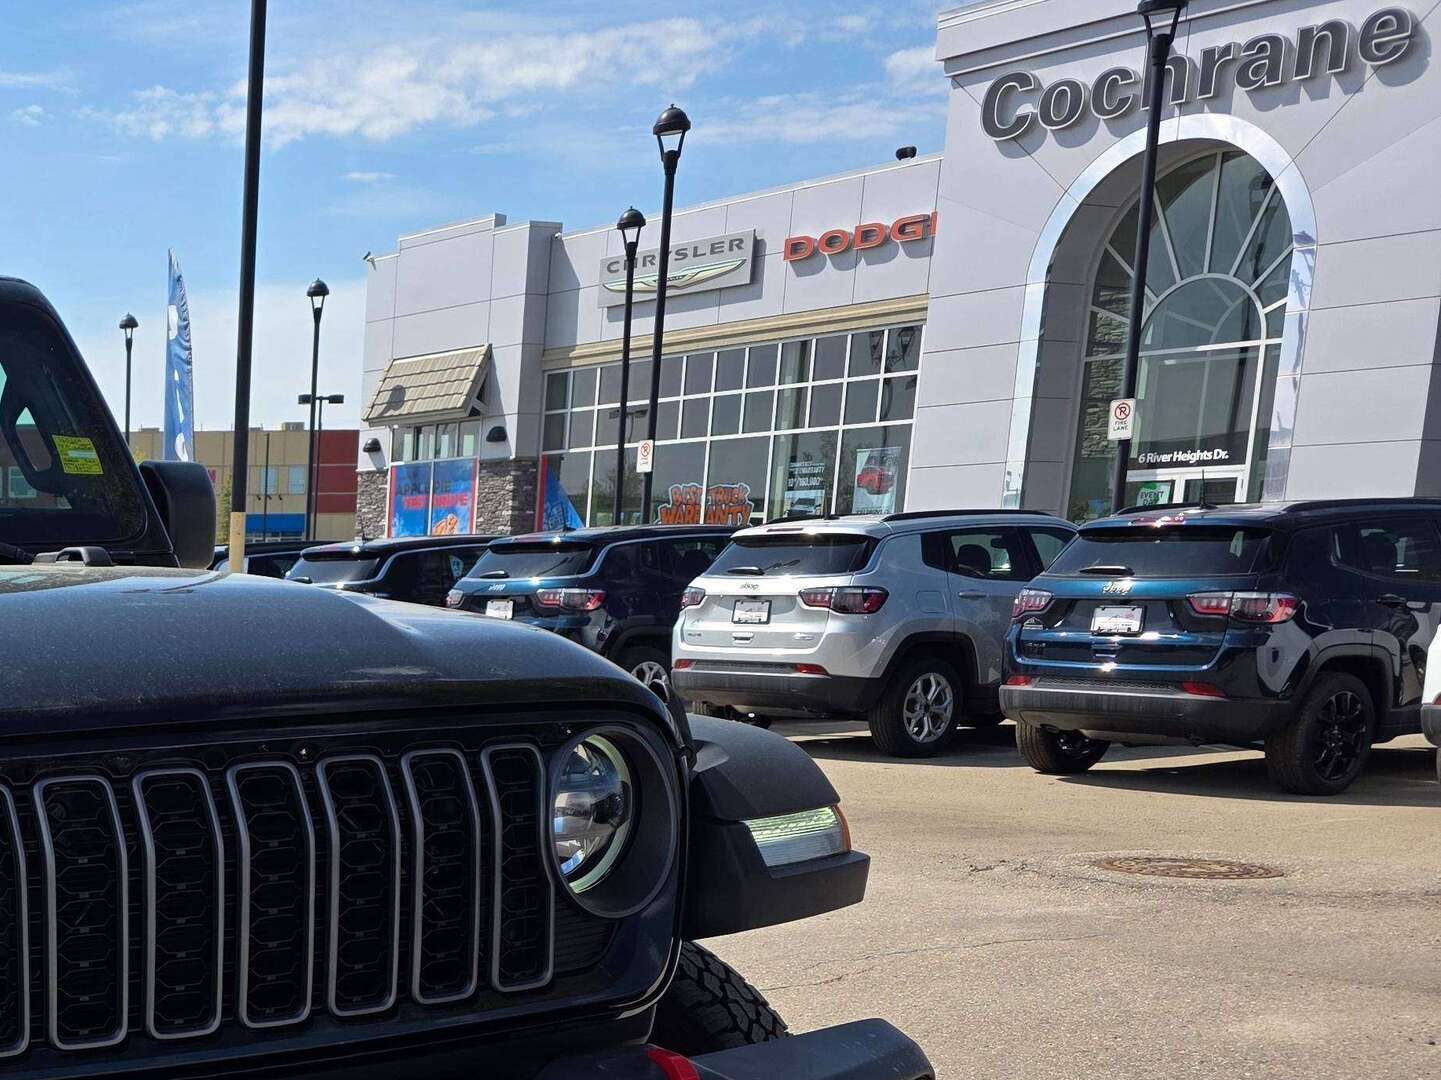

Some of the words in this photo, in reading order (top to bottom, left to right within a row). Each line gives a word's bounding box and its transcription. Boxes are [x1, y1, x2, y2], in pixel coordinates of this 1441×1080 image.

[980, 6, 1413, 141] Cochrane
[606, 238, 745, 274] CHRSLER
[1138, 453, 1146, 464] 6
[1146, 452, 1173, 463] River
[1173, 449, 1213, 464] Heights
[1213, 448, 1229, 460] Dr.
